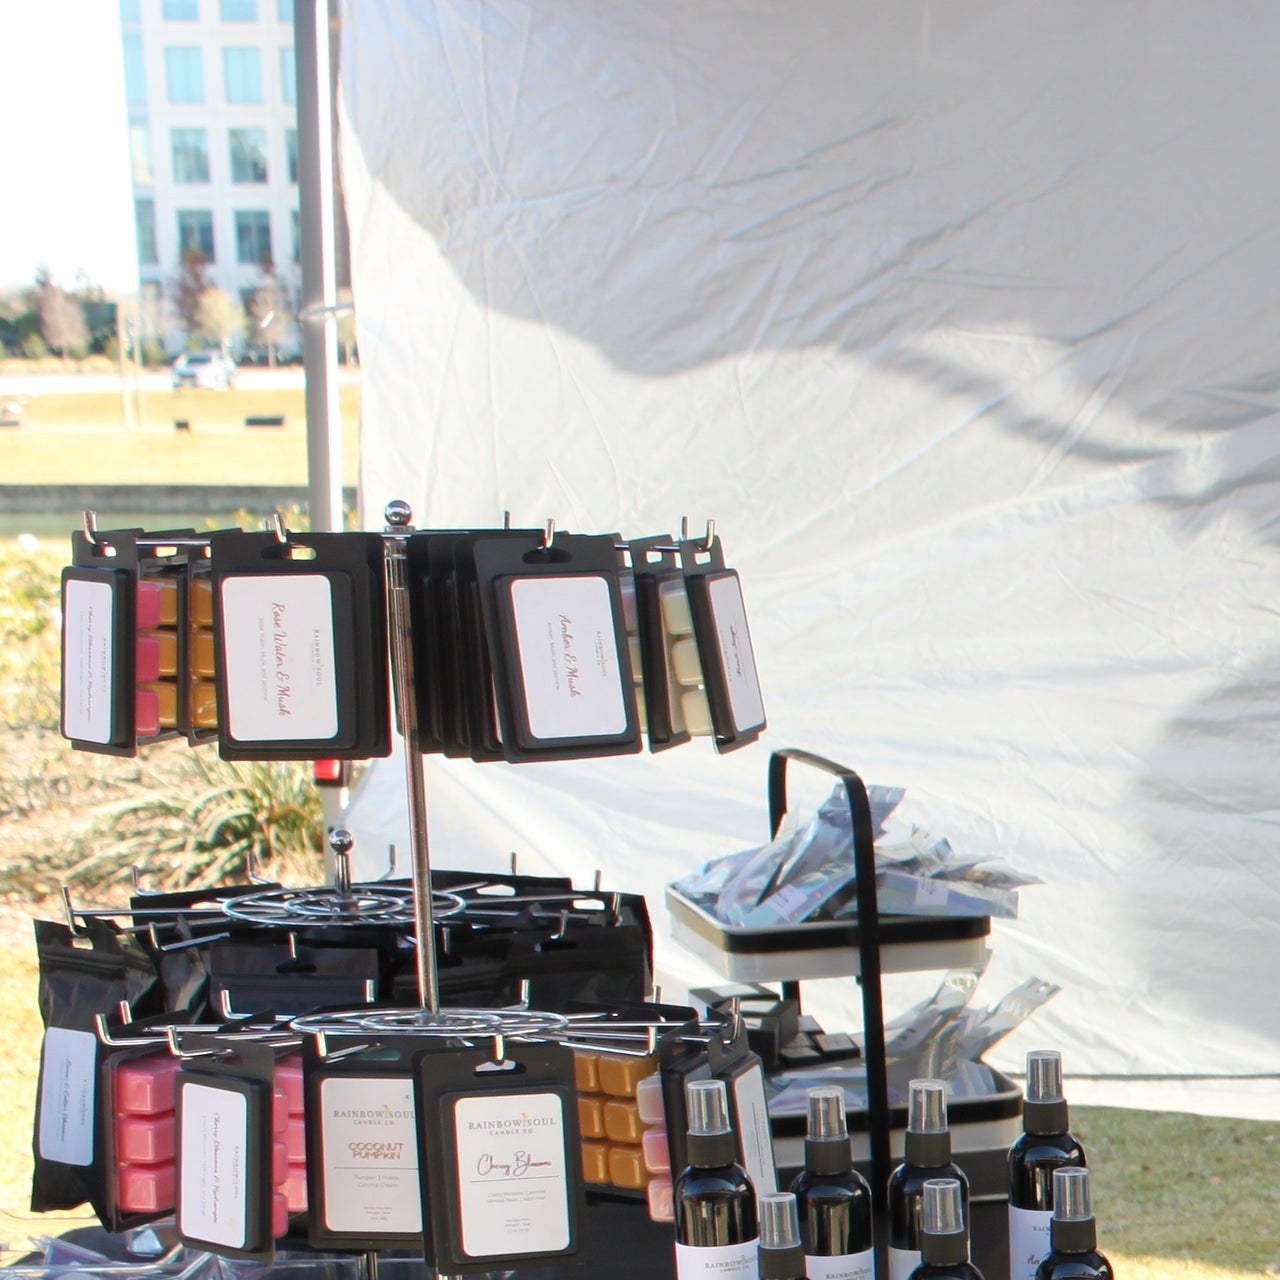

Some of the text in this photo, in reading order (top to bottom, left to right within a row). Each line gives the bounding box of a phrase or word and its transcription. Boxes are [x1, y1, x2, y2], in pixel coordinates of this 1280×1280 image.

[313, 628, 321, 665] RAINBOW
[271, 602, 293, 717] Rose Water & Musk
[558, 614, 582, 698] Amber & Musk
[333, 1110, 416, 1120] RAINBOW SOUL
[468, 1117, 557, 1131] RAINBOW SOUL
[489, 1128, 520, 1136] CANDLE
[348, 1142, 404, 1151] COCONUT
[352, 1151, 401, 1160] PUMPKIN
[704, 1259, 742, 1270] RAINBOW
